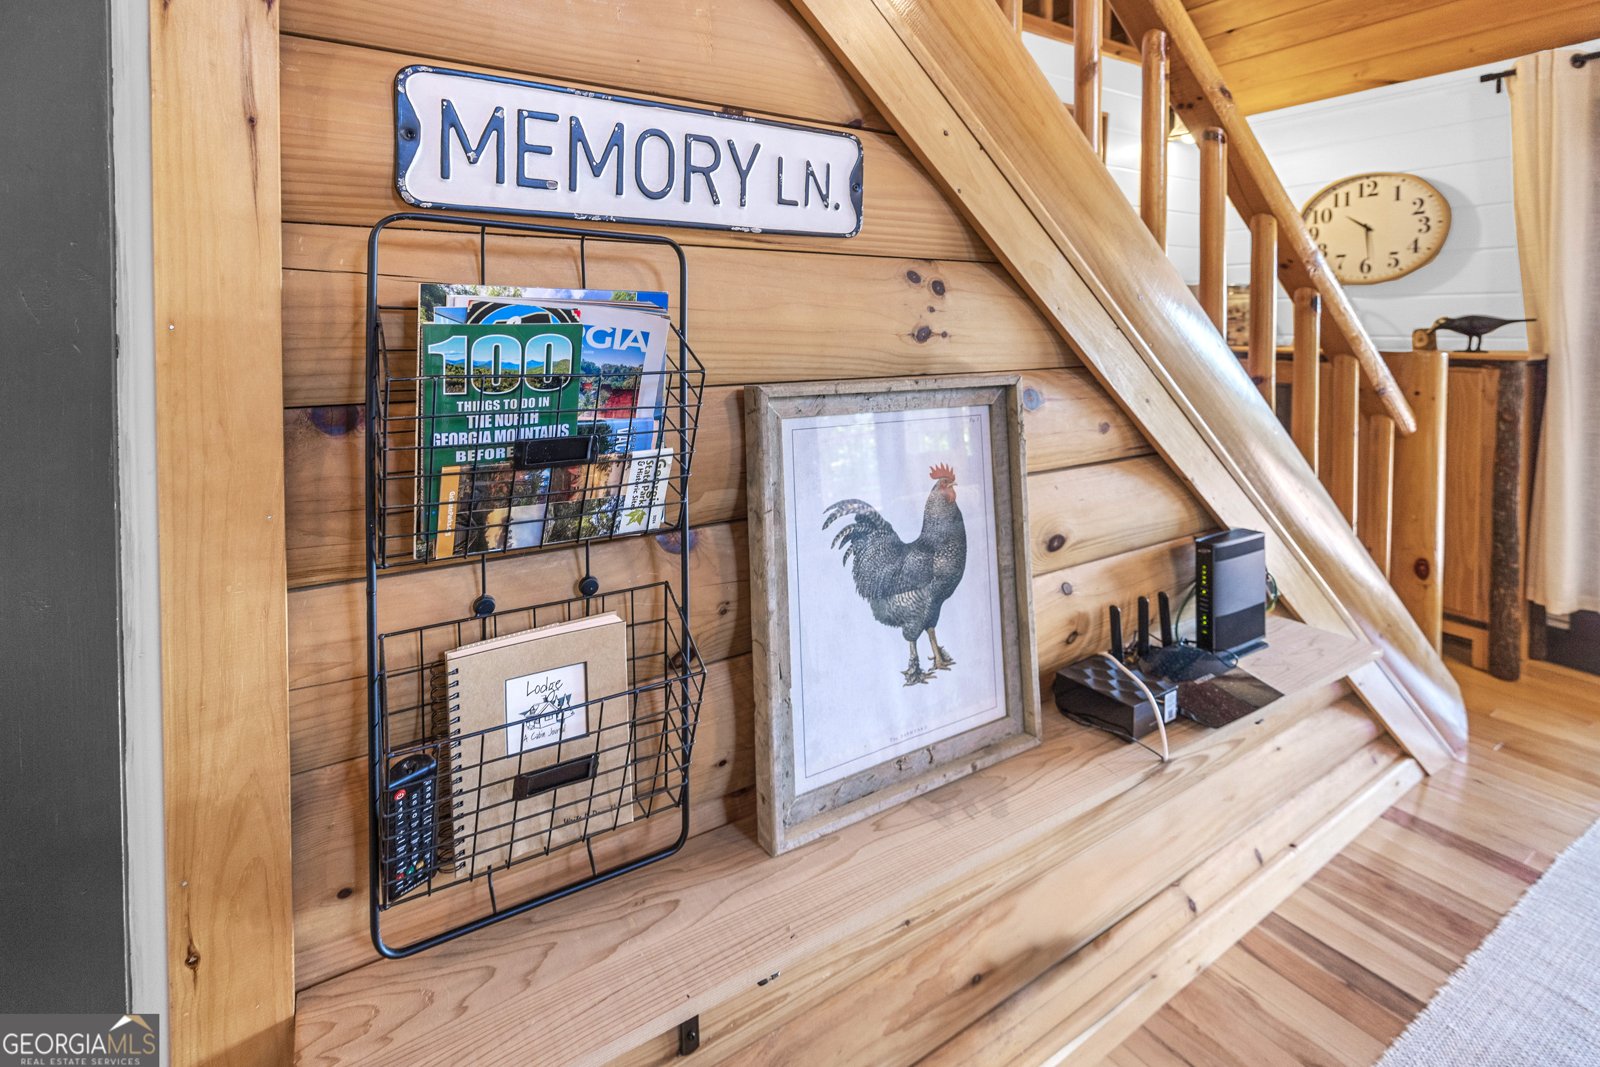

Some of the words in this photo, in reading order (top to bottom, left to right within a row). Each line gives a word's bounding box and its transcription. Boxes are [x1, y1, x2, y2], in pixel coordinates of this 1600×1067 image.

[440, 98, 761, 207] MEMORY
[776, 156, 841, 211] LN.
[1358, 180, 1379, 198] 12
[1395, 185, 1400, 201] 1
[1333, 191, 1351, 208] 11
[1411, 197, 1425, 215] 2
[1312, 208, 1333, 224] 10
[1418, 216, 1431, 233] 3
[1309, 226, 1319, 241] 9
[1318, 243, 1328, 258] 8
[1407, 237, 1421, 254] 4
[1336, 254, 1346, 270] 7
[1359, 257, 1372, 274] 6
[1387, 251, 1399, 268] 5
[582, 325, 648, 352] GIA
[428, 333, 573, 396] 100
[457, 400, 500, 412] THINGS
[503, 399, 517, 410] TO
[521, 397, 535, 408] DO
[538, 396, 550, 407] IN
[466, 414, 492, 429] THE
[433, 430, 491, 447] GEORGIA
[456, 446, 514, 462] BEFORE
[642, 460, 654, 483] State
[526, 676, 563, 699] Lodge
